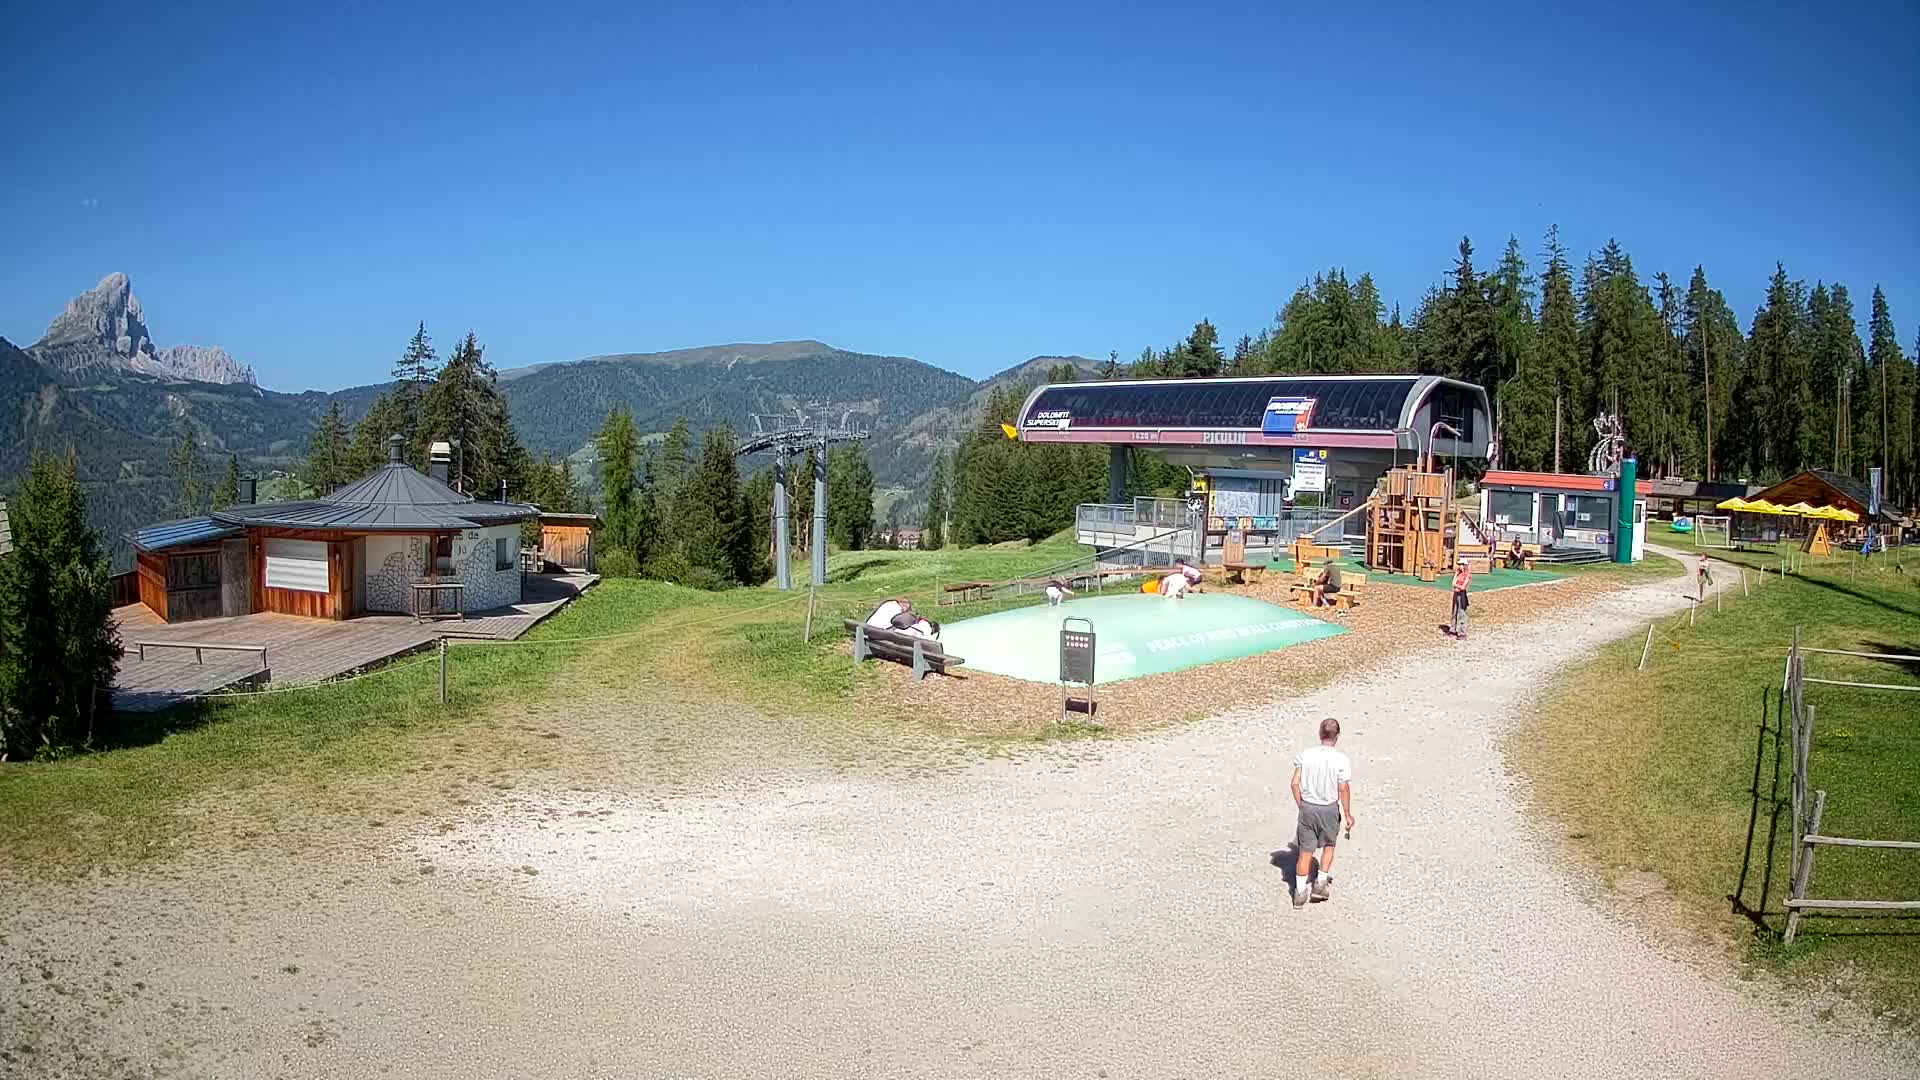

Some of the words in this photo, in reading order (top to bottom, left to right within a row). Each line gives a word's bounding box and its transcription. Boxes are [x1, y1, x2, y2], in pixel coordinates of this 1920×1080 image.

[1037, 411, 1070, 419] DOLOMITI
[1026, 419, 1060, 427] SUPERSKI
[1202, 432, 1246, 444] PICULIN
[1146, 634, 1191, 653] PEACE
